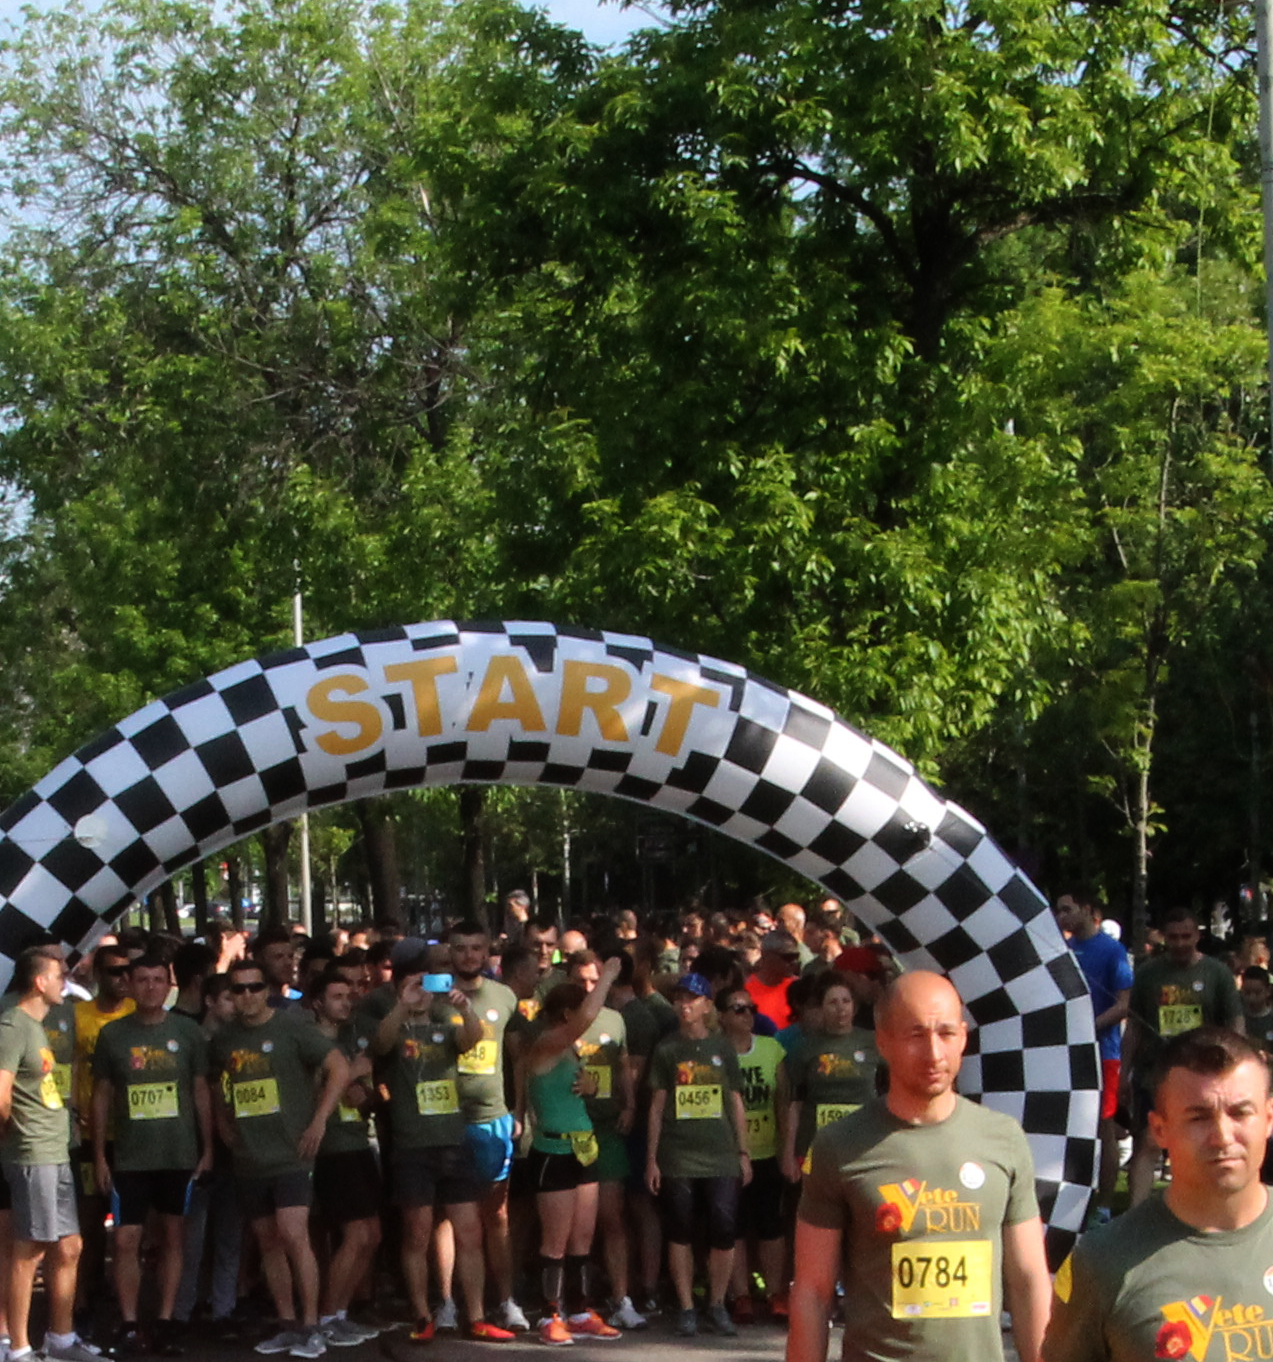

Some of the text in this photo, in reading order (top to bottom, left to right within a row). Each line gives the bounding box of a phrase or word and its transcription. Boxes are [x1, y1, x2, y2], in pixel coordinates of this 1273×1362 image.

[305, 655, 720, 757] START
[678, 1090, 711, 1106] 0456
[925, 1205, 980, 1232] RUN
[898, 1256, 968, 1289] 0784
